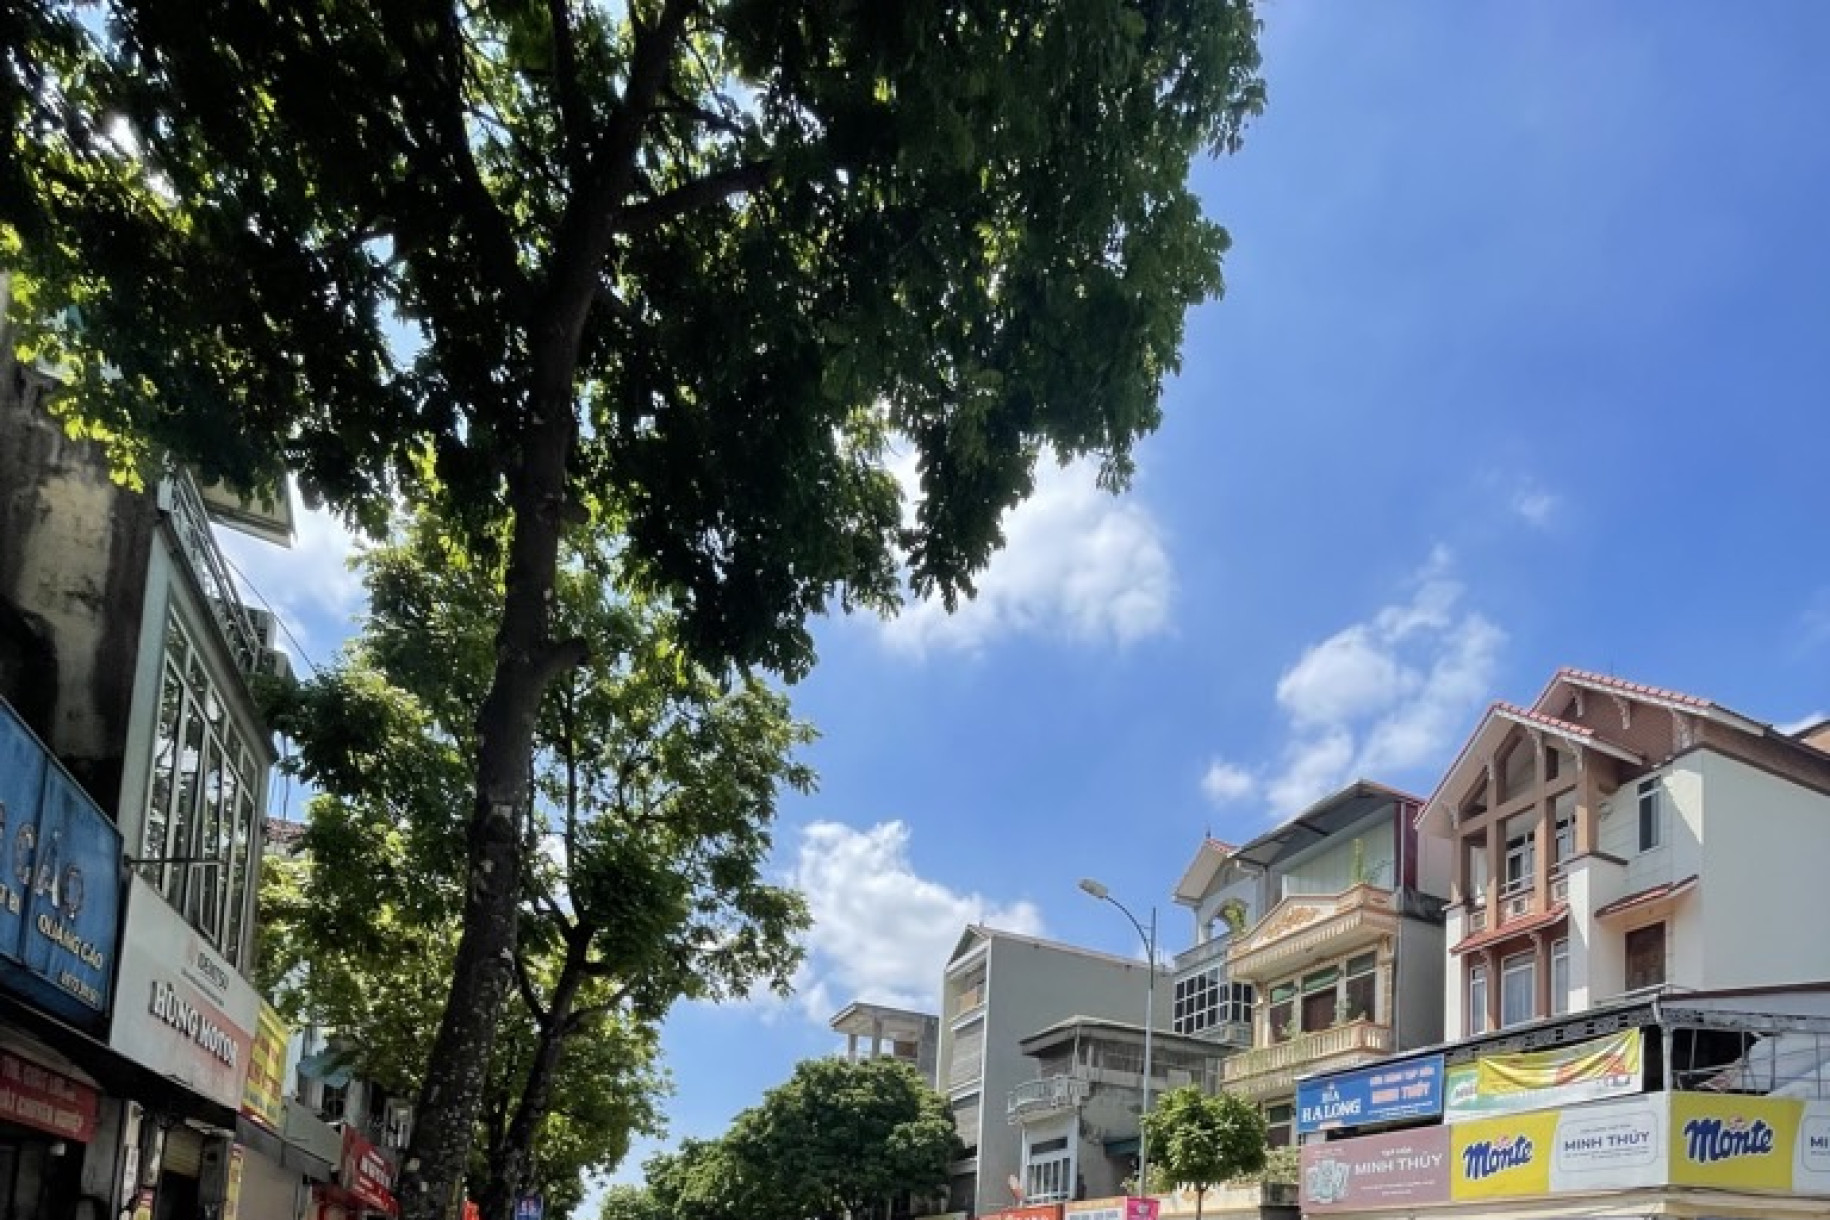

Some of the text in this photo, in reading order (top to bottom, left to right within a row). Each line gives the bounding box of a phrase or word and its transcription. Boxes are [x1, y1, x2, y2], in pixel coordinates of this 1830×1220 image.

[1564, 1136, 1602, 1152] MINH
[1683, 1117, 1774, 1164] Monte
[1355, 1160, 1393, 1176] MINH
[1462, 1133, 1534, 1180] Monte
